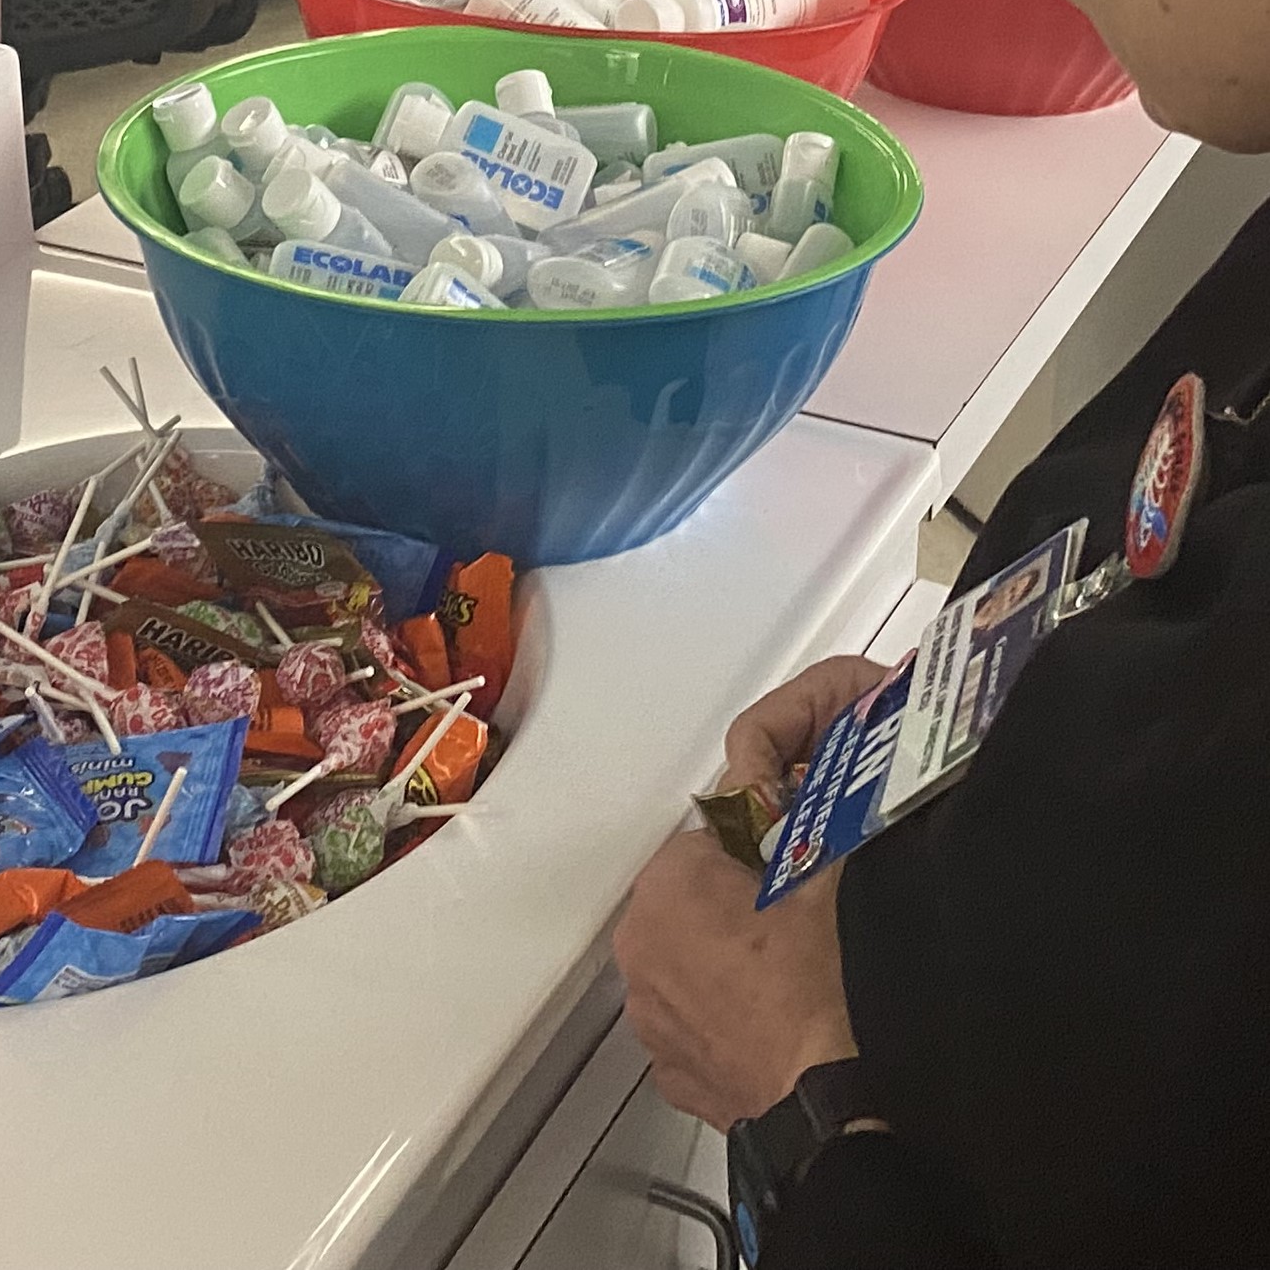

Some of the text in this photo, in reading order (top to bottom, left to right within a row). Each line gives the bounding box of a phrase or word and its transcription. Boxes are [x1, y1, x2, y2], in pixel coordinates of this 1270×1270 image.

[293, 245, 416, 287] ECOLAB
[227, 537, 326, 568] HARIBO
[844, 711, 902, 798] RN
